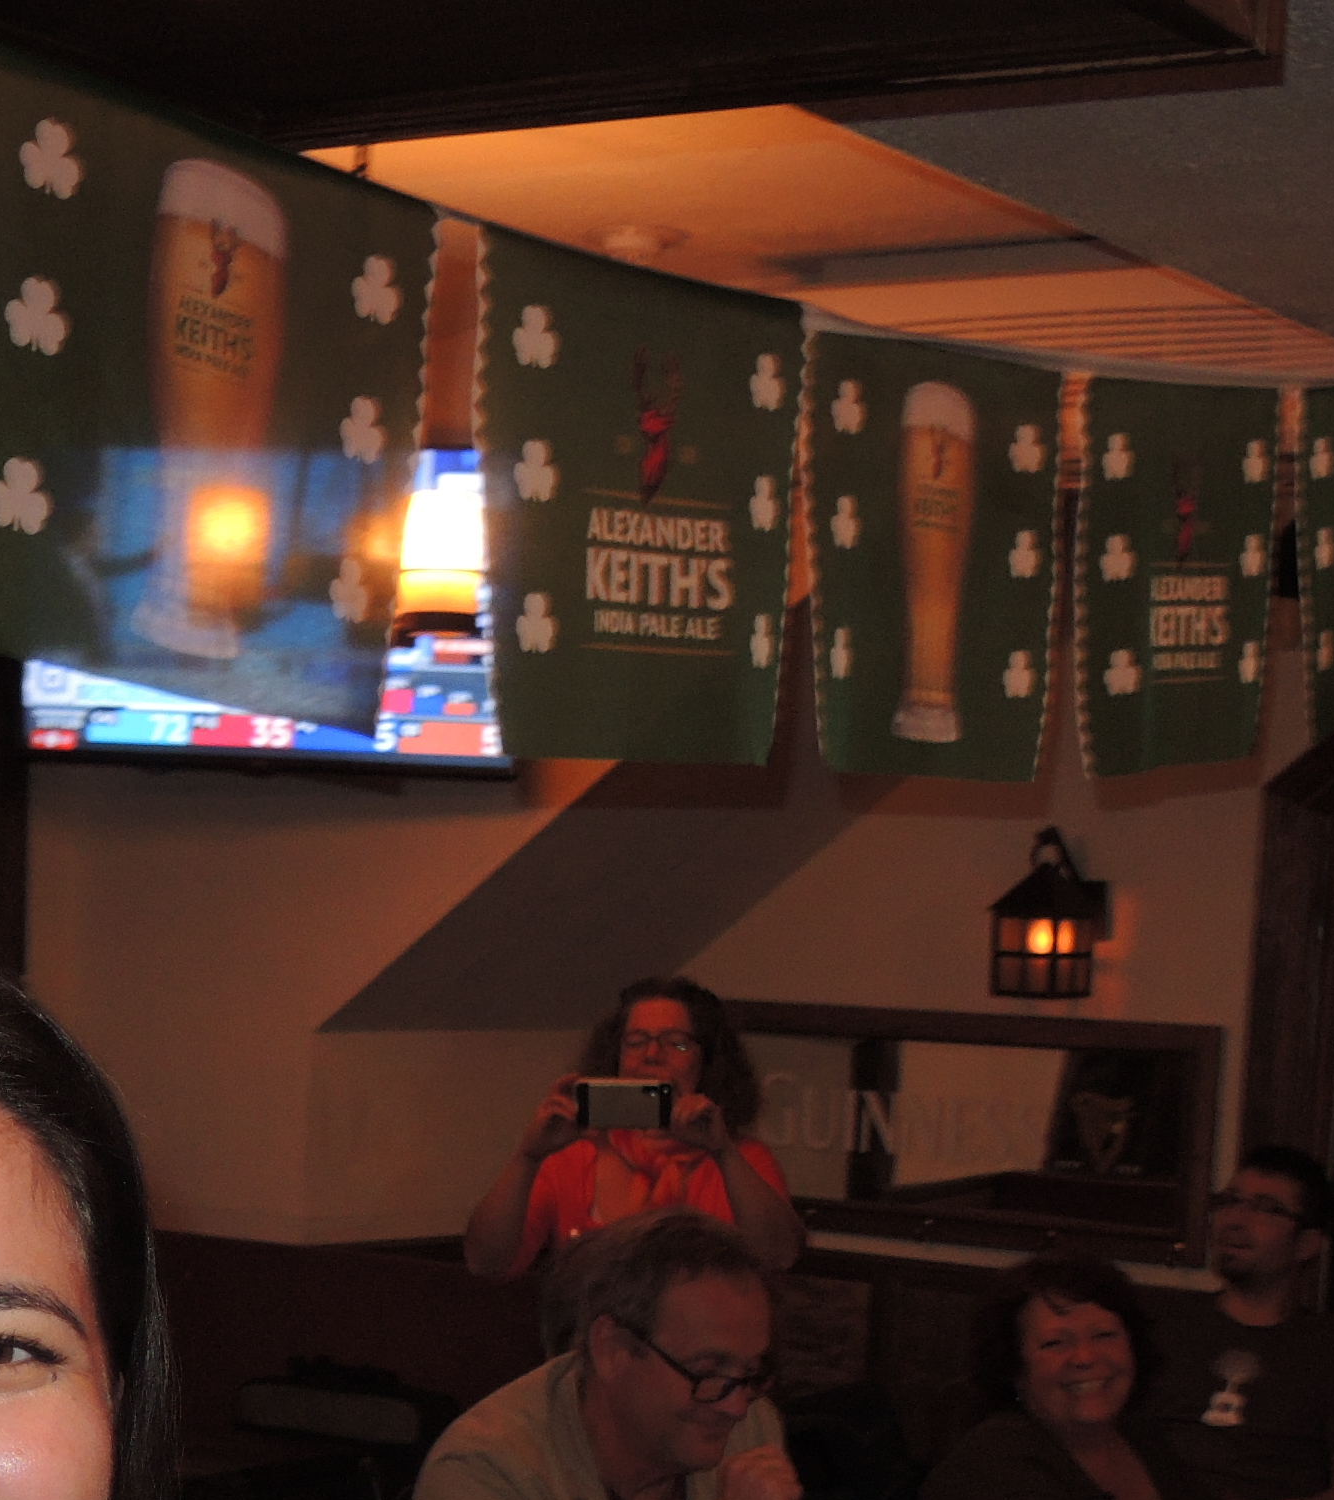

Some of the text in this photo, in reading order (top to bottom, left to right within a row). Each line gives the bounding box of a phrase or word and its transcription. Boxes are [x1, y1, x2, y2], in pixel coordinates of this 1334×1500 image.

[588, 507, 731, 552] ALEXANDER
[586, 546, 735, 610] KEITH'S
[594, 609, 721, 640] INDIA PALE ALE
[149, 713, 188, 742] 72
[249, 716, 292, 747] 35
